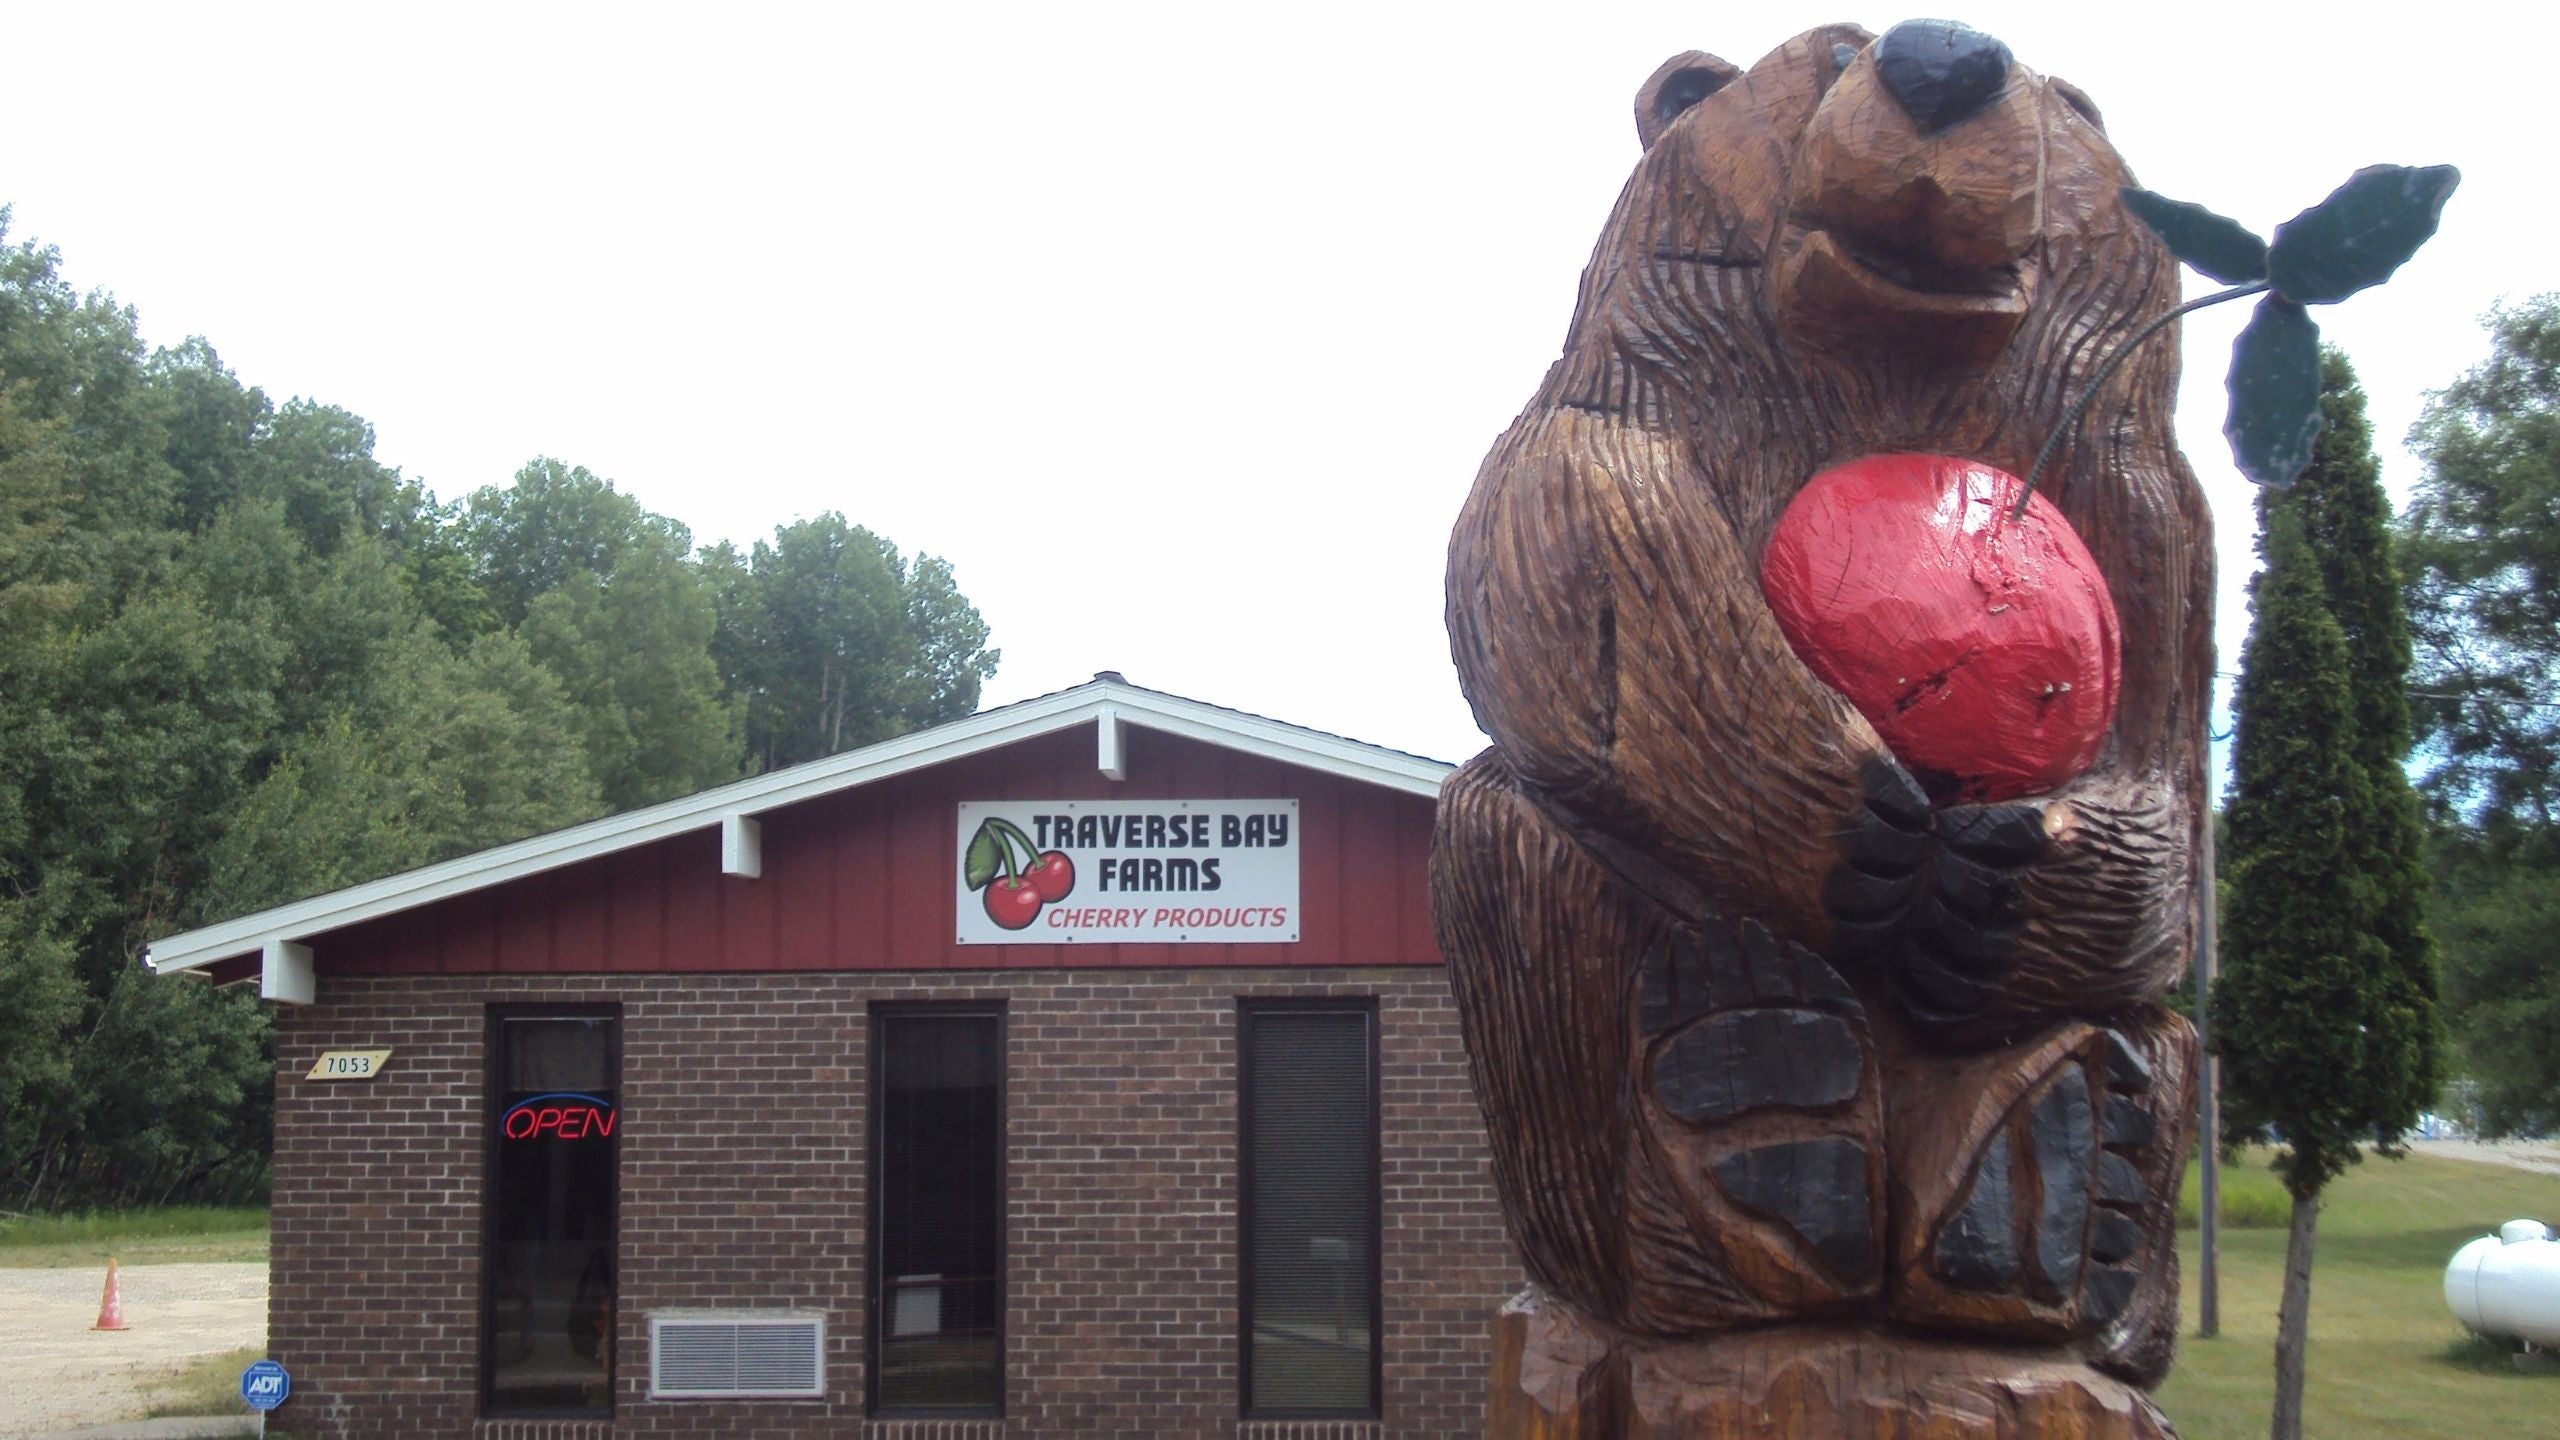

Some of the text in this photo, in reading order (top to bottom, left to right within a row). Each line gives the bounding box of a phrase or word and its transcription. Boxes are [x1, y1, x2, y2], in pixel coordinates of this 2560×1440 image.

[1033, 814, 1288, 849] TRAVERSE BAY
[1099, 858, 1221, 892] FARMS
[1047, 907, 1287, 928] CHERRY PRODUCTS
[327, 1057, 370, 1073] 7053
[505, 1108, 616, 1139] OPEN
[247, 1376, 282, 1394] ADT
